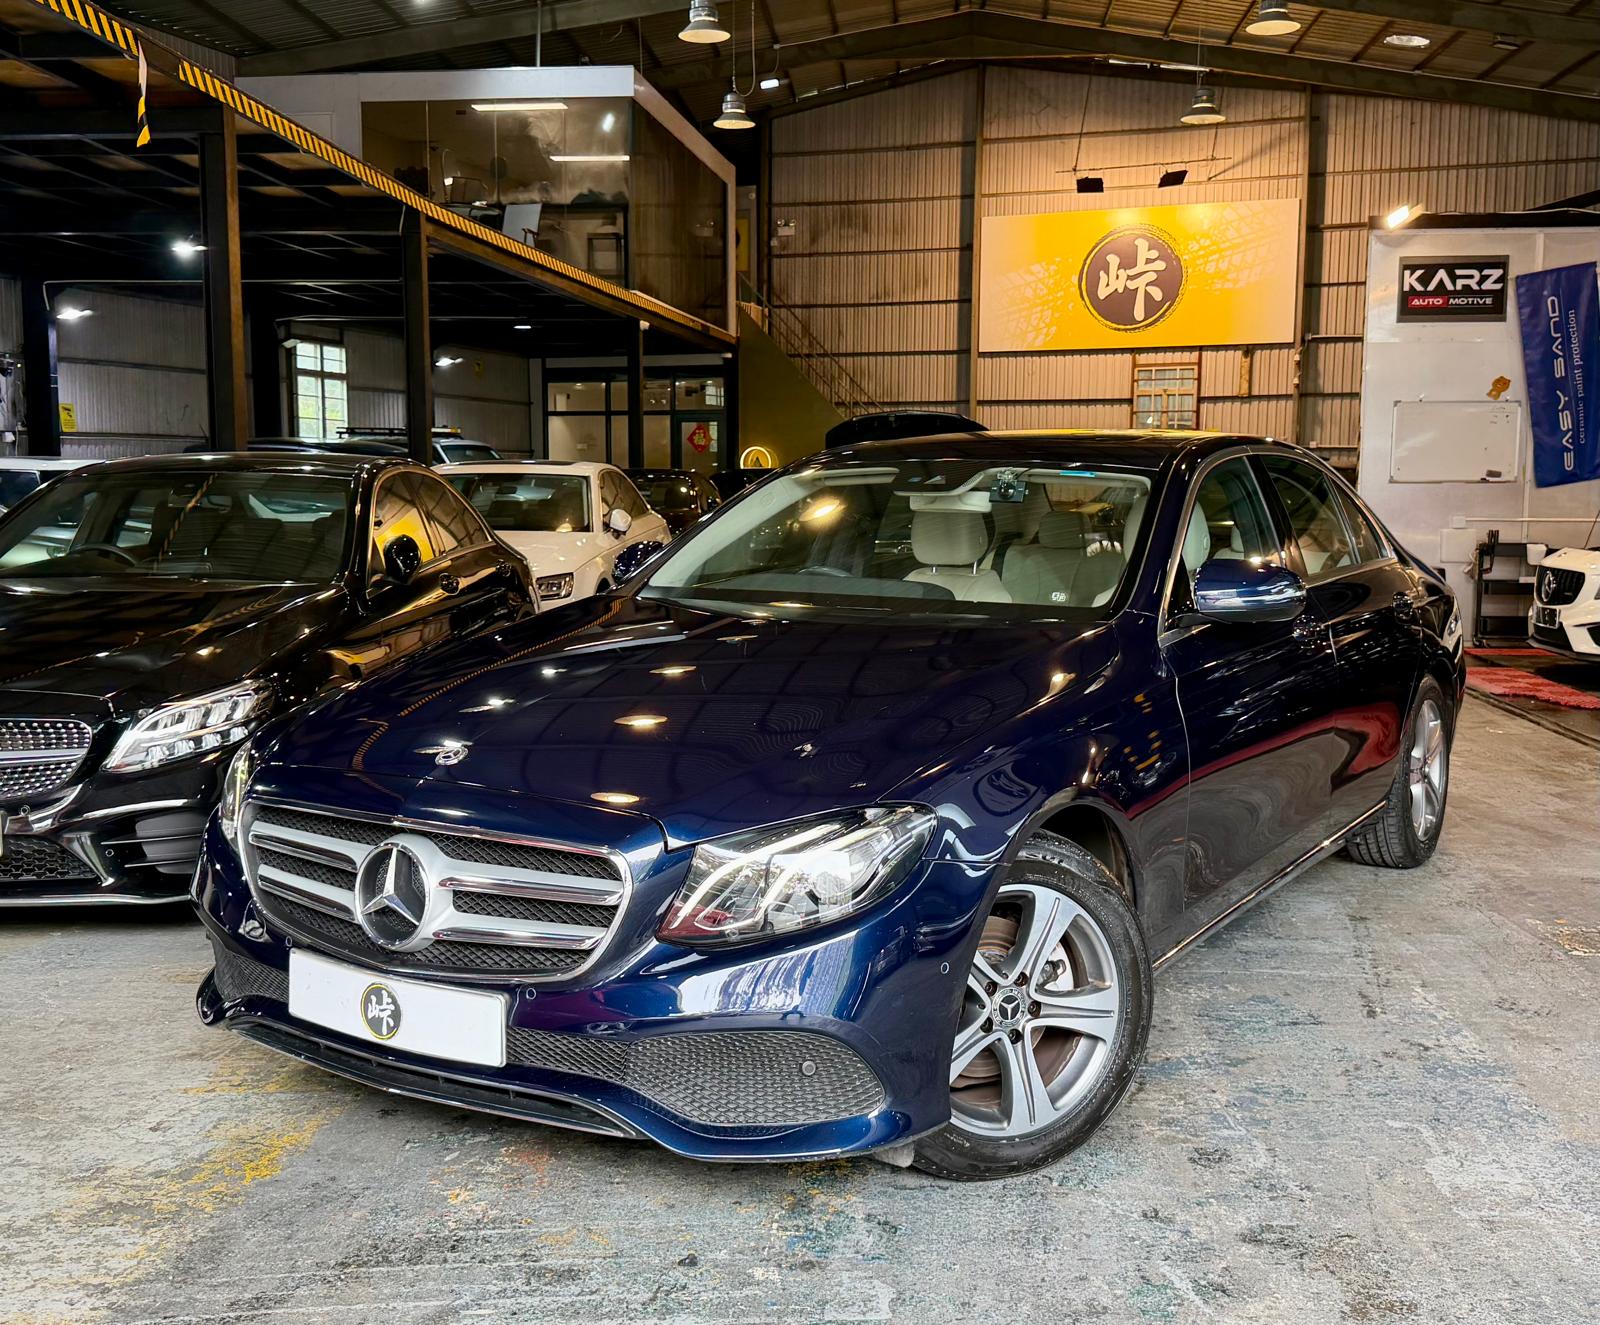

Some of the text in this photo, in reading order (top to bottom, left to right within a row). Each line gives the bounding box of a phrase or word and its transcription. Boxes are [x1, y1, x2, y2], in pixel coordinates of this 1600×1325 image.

[1097, 238, 1167, 321] 峠
[1403, 269, 1504, 291] KARZ
[1411, 297, 1494, 306] AUTO MOTIVE
[1547, 296, 1574, 471] EASY SAND
[1567, 309, 1586, 444] ceramic paint protection
[368, 990, 395, 1035] 峠
